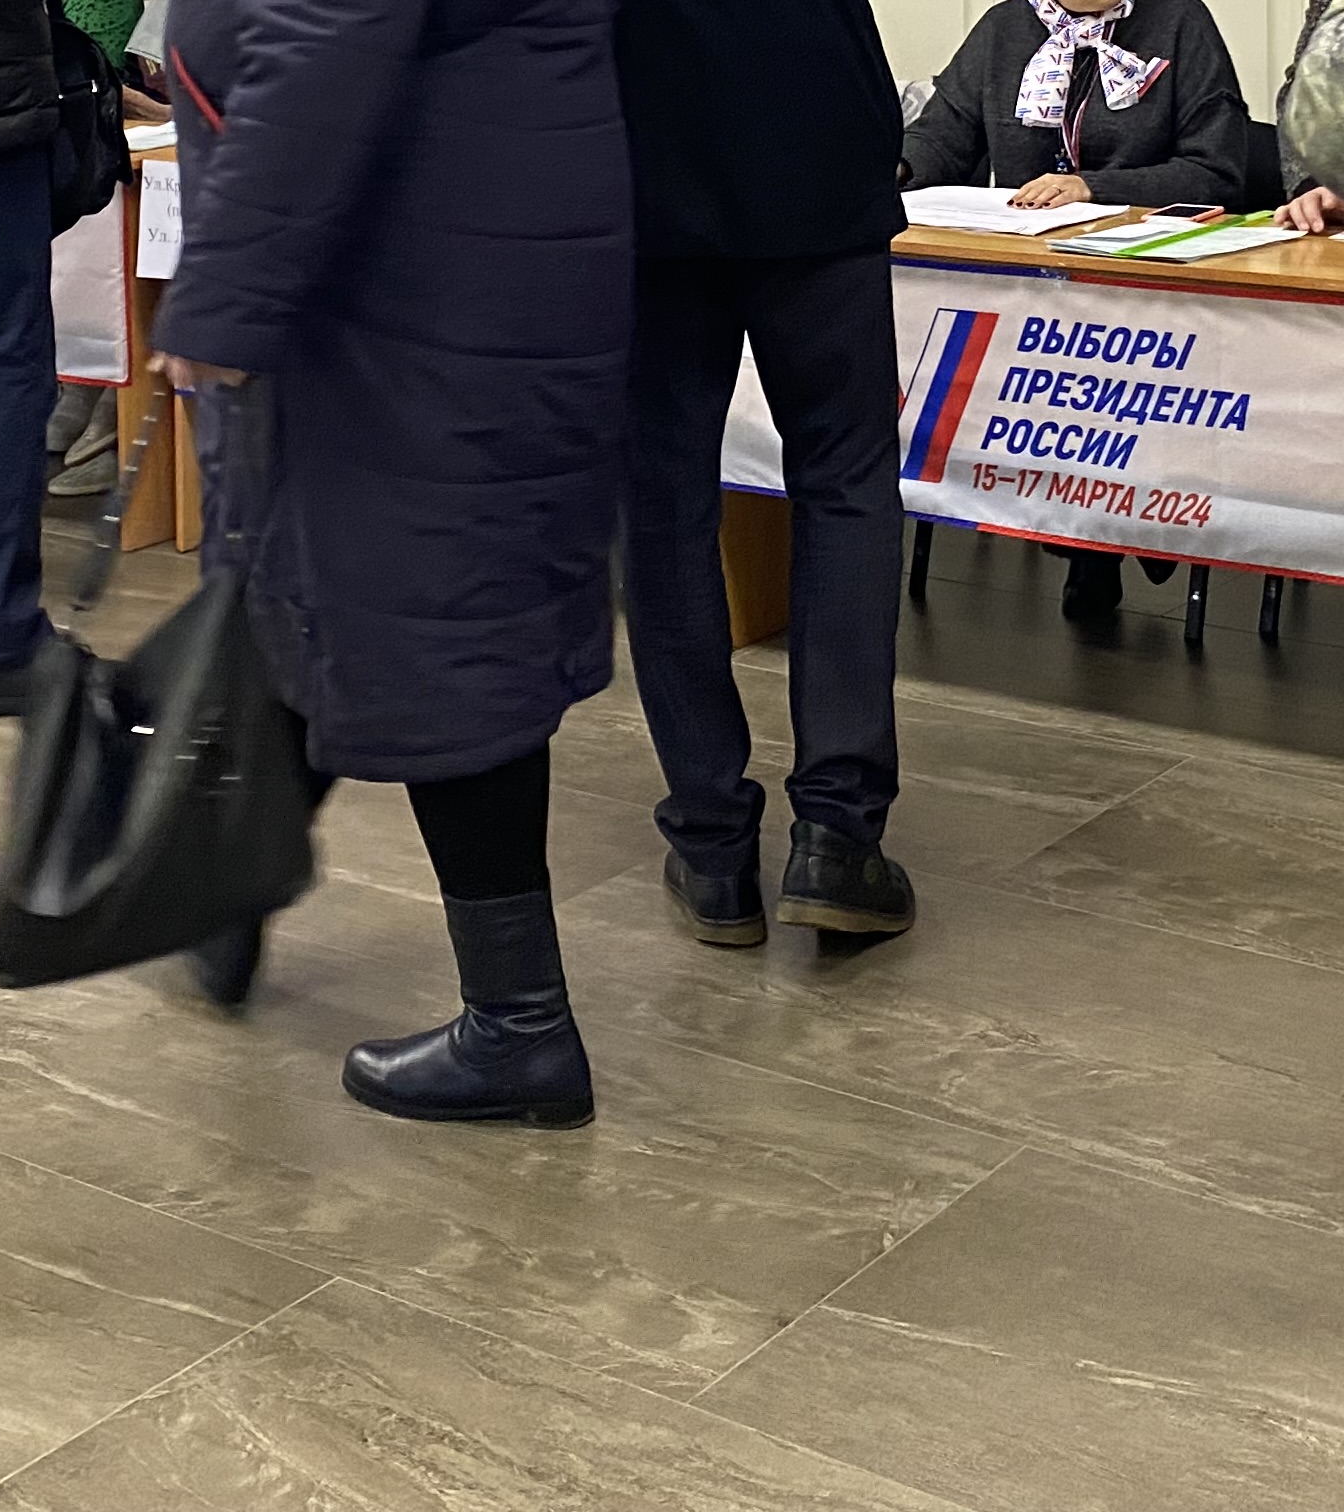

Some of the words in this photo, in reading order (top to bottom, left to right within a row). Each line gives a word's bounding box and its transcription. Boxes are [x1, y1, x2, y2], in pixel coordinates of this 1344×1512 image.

[1016, 316, 1197, 370] ВЫБОРЫ
[998, 366, 1251, 431] ПРЕЗИДЕНТА
[980, 415, 1139, 470] РОССИИ
[1045, 472, 1137, 517] МАРТА
[1139, 489, 1213, 528] 2024
